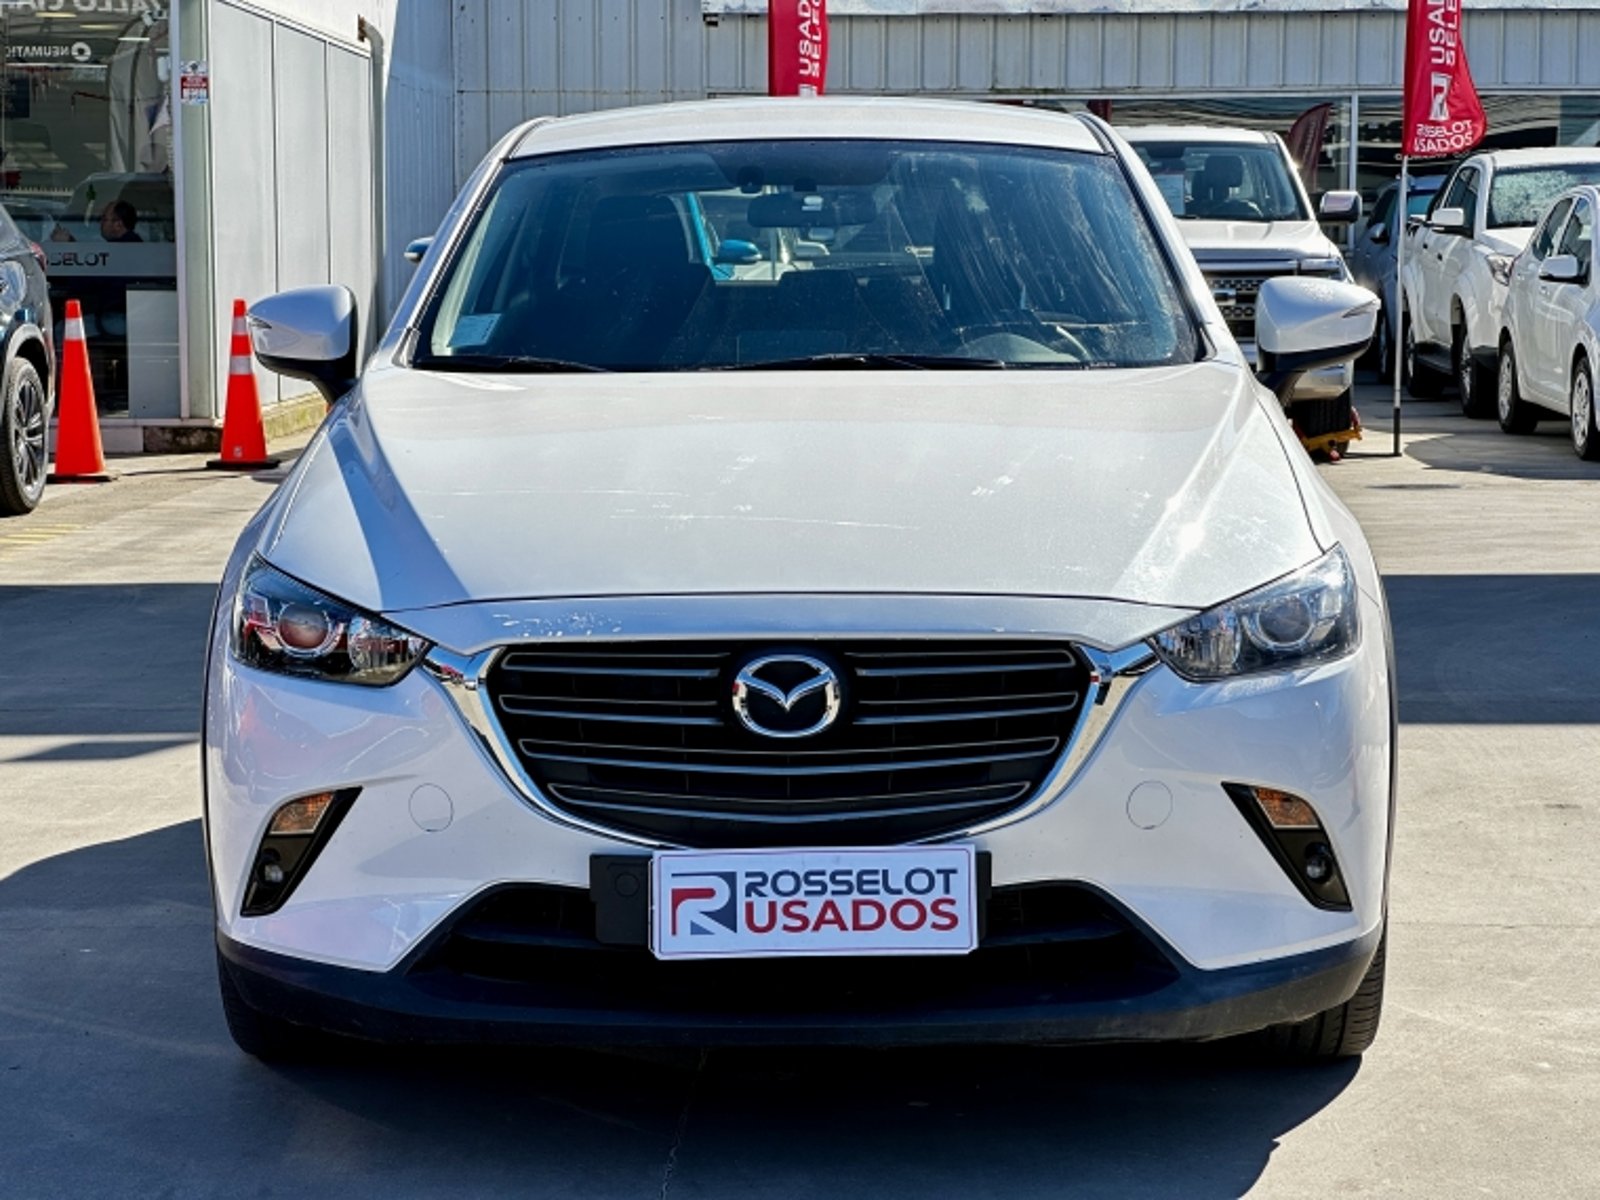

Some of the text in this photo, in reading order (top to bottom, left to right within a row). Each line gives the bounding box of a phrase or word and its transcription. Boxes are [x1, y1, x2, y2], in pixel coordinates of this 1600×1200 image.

[1428, 0, 1445, 64] USA
[745, 868, 957, 897] ROSSELOT
[745, 898, 959, 933] USADOS
